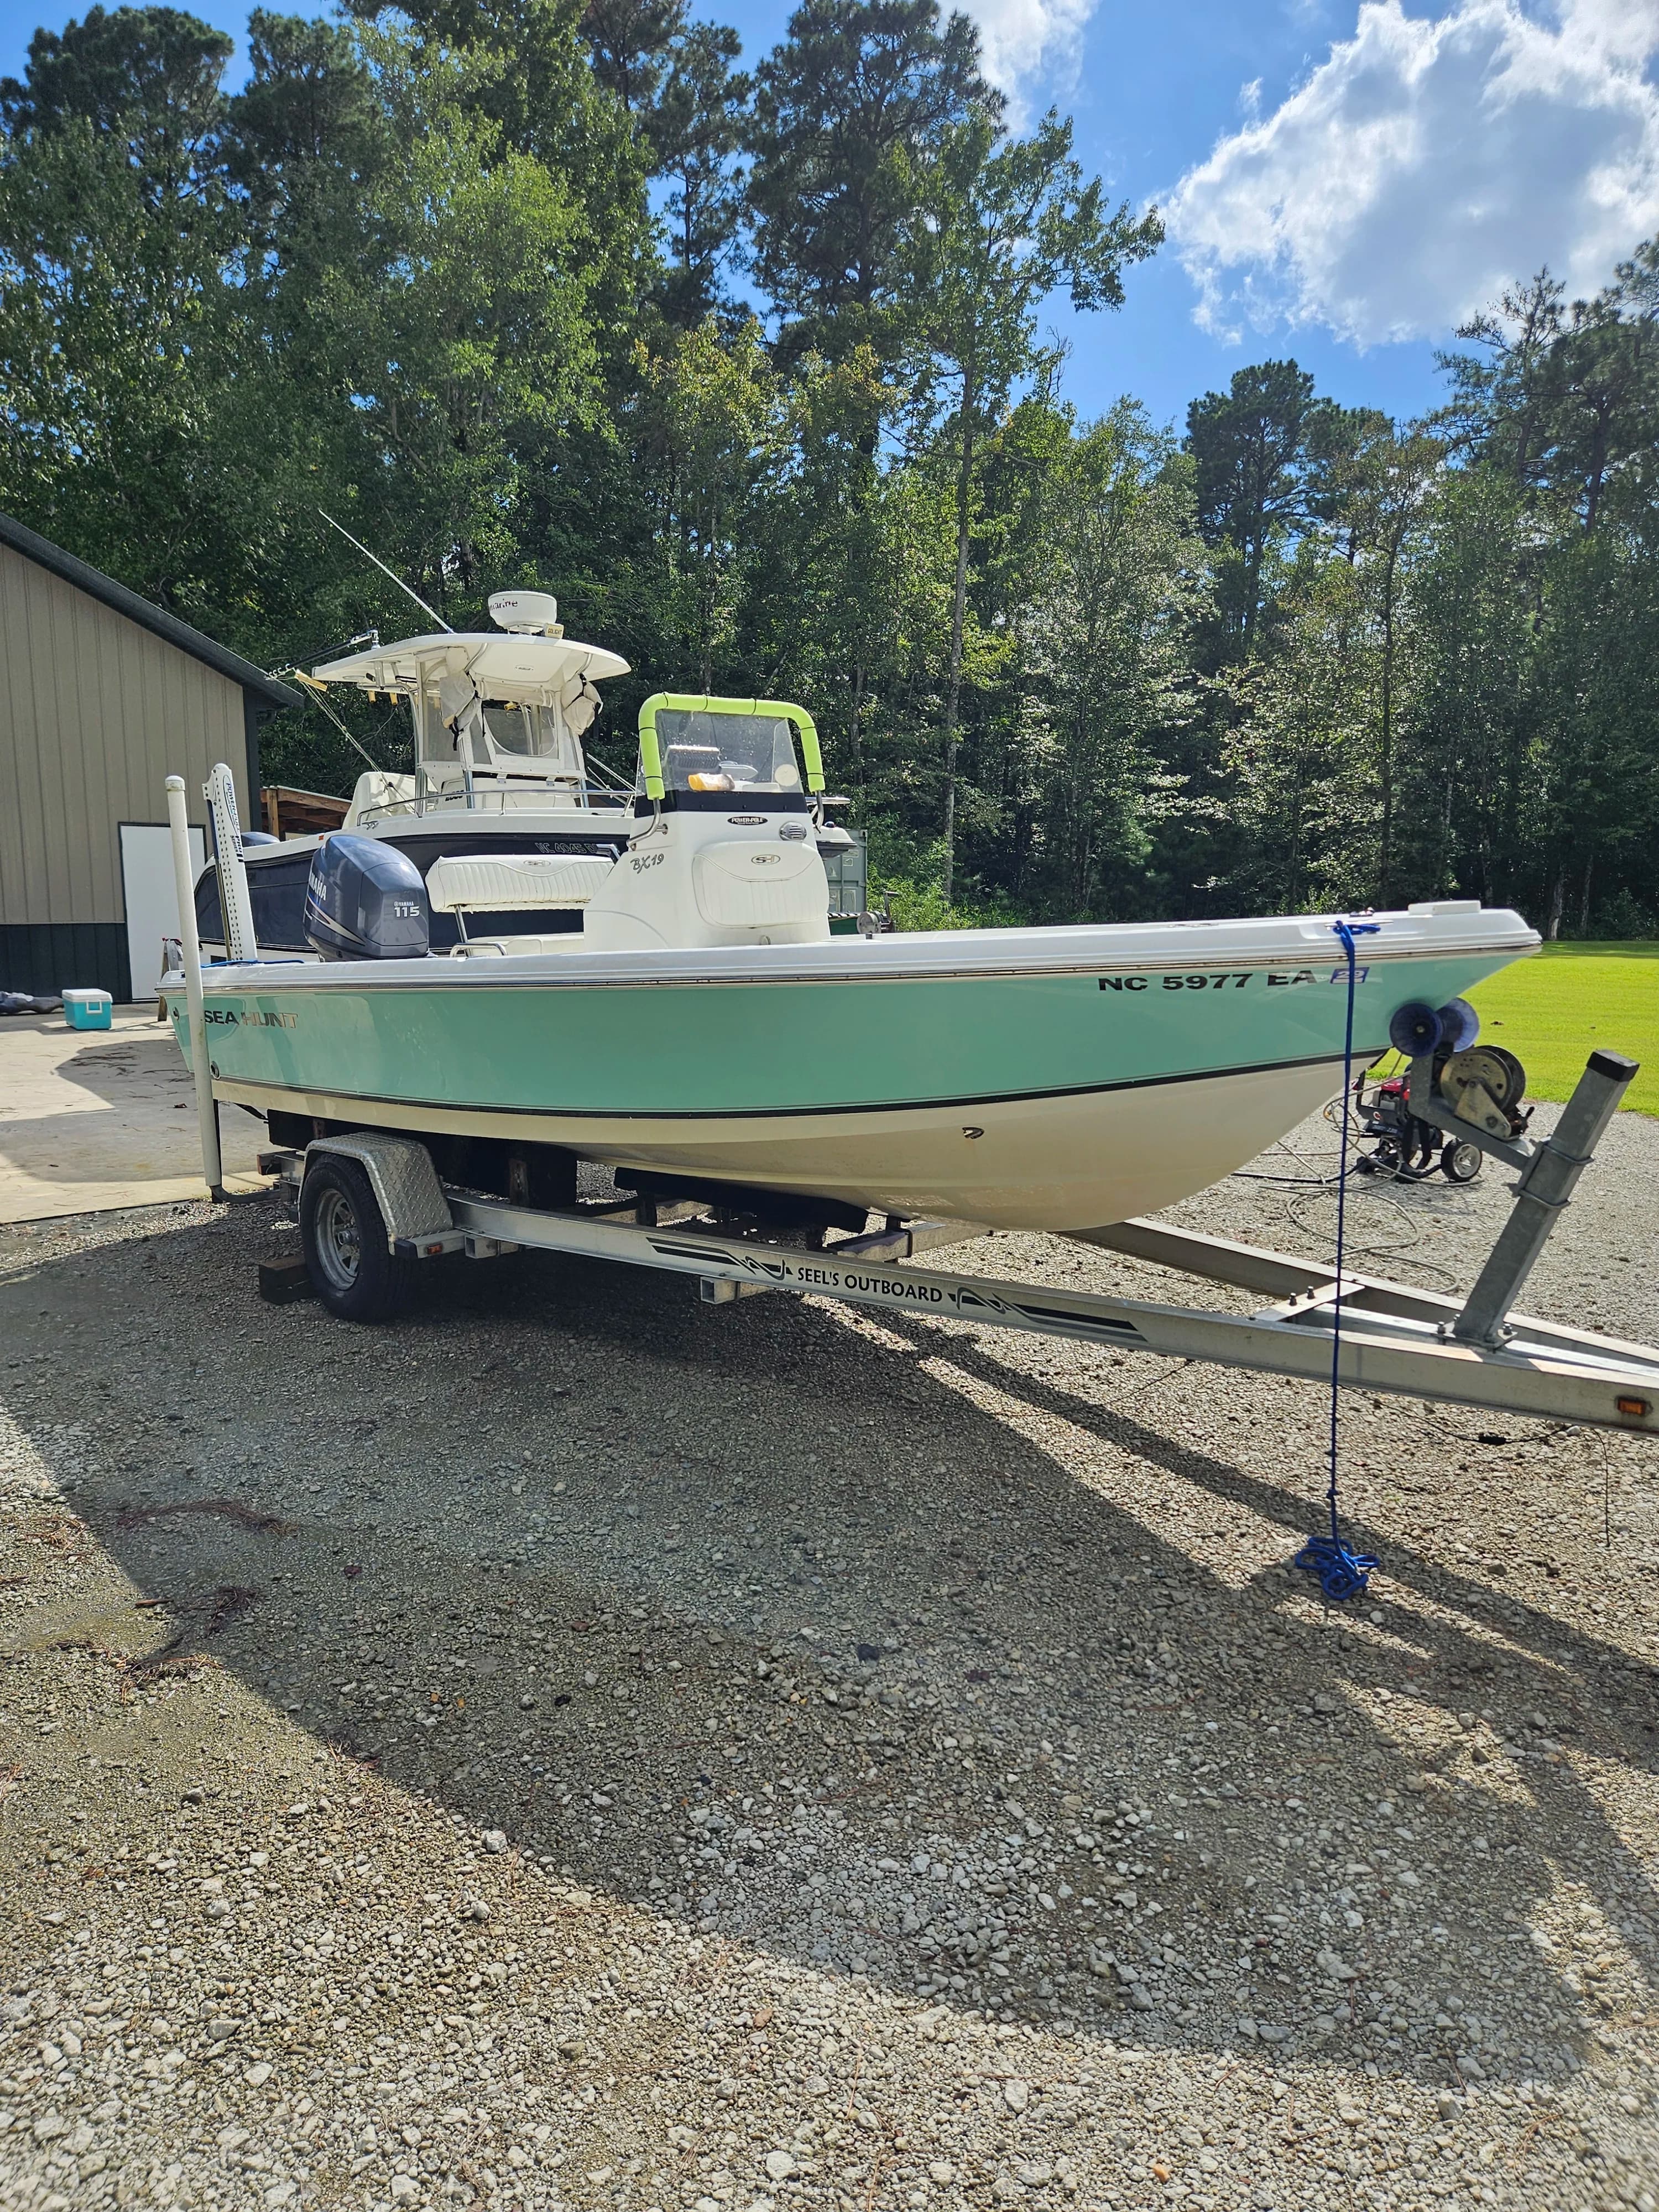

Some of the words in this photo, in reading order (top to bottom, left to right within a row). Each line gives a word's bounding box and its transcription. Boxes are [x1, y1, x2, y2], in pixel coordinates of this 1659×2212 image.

[630, 855, 650, 874] BX
[651, 853, 664, 865] 19
[394, 906, 420, 917] 115
[1098, 977, 1148, 991] NC
[1162, 973, 1254, 990] 5977
[1267, 970, 1317, 987] EA
[204, 1010, 239, 1025] SEA
[241, 1011, 299, 1029] HUNT
[797, 1267, 839, 1286] SEEL'S
[844, 1274, 943, 1302] OUTBOARD
